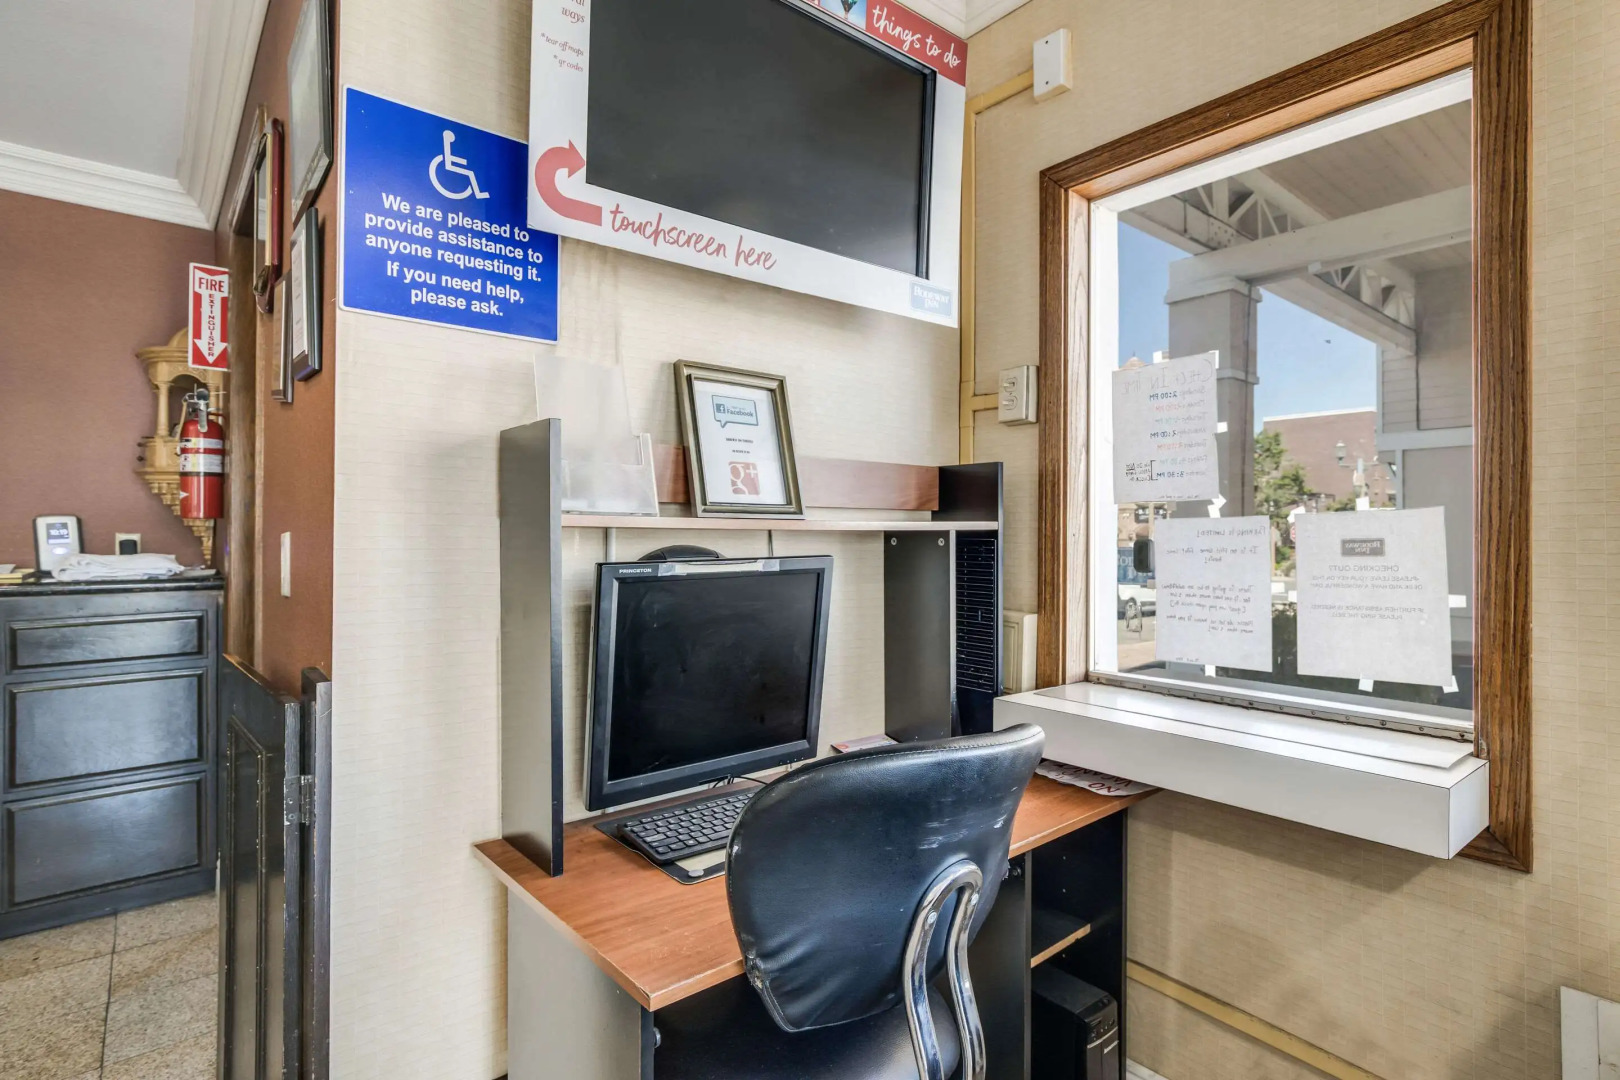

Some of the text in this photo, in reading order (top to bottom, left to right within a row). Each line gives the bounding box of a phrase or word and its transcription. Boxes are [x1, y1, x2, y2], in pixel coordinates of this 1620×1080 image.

[561, 7, 585, 24] ways
[872, 5, 961, 68] things to do
[365, 212, 543, 264] provide assistance to
[382, 192, 530, 242] We are pleased to
[609, 203, 777, 270] touchscreen here
[365, 233, 542, 282] anyone requesting it.
[198, 277, 225, 293] FIRE
[387, 261, 524, 304] If you need help,
[411, 288, 504, 317] please ask.
[208, 293, 216, 357] EXTINGUISHER
[727, 408, 754, 417] Facebook
[1088, 782, 1121, 794] NO
